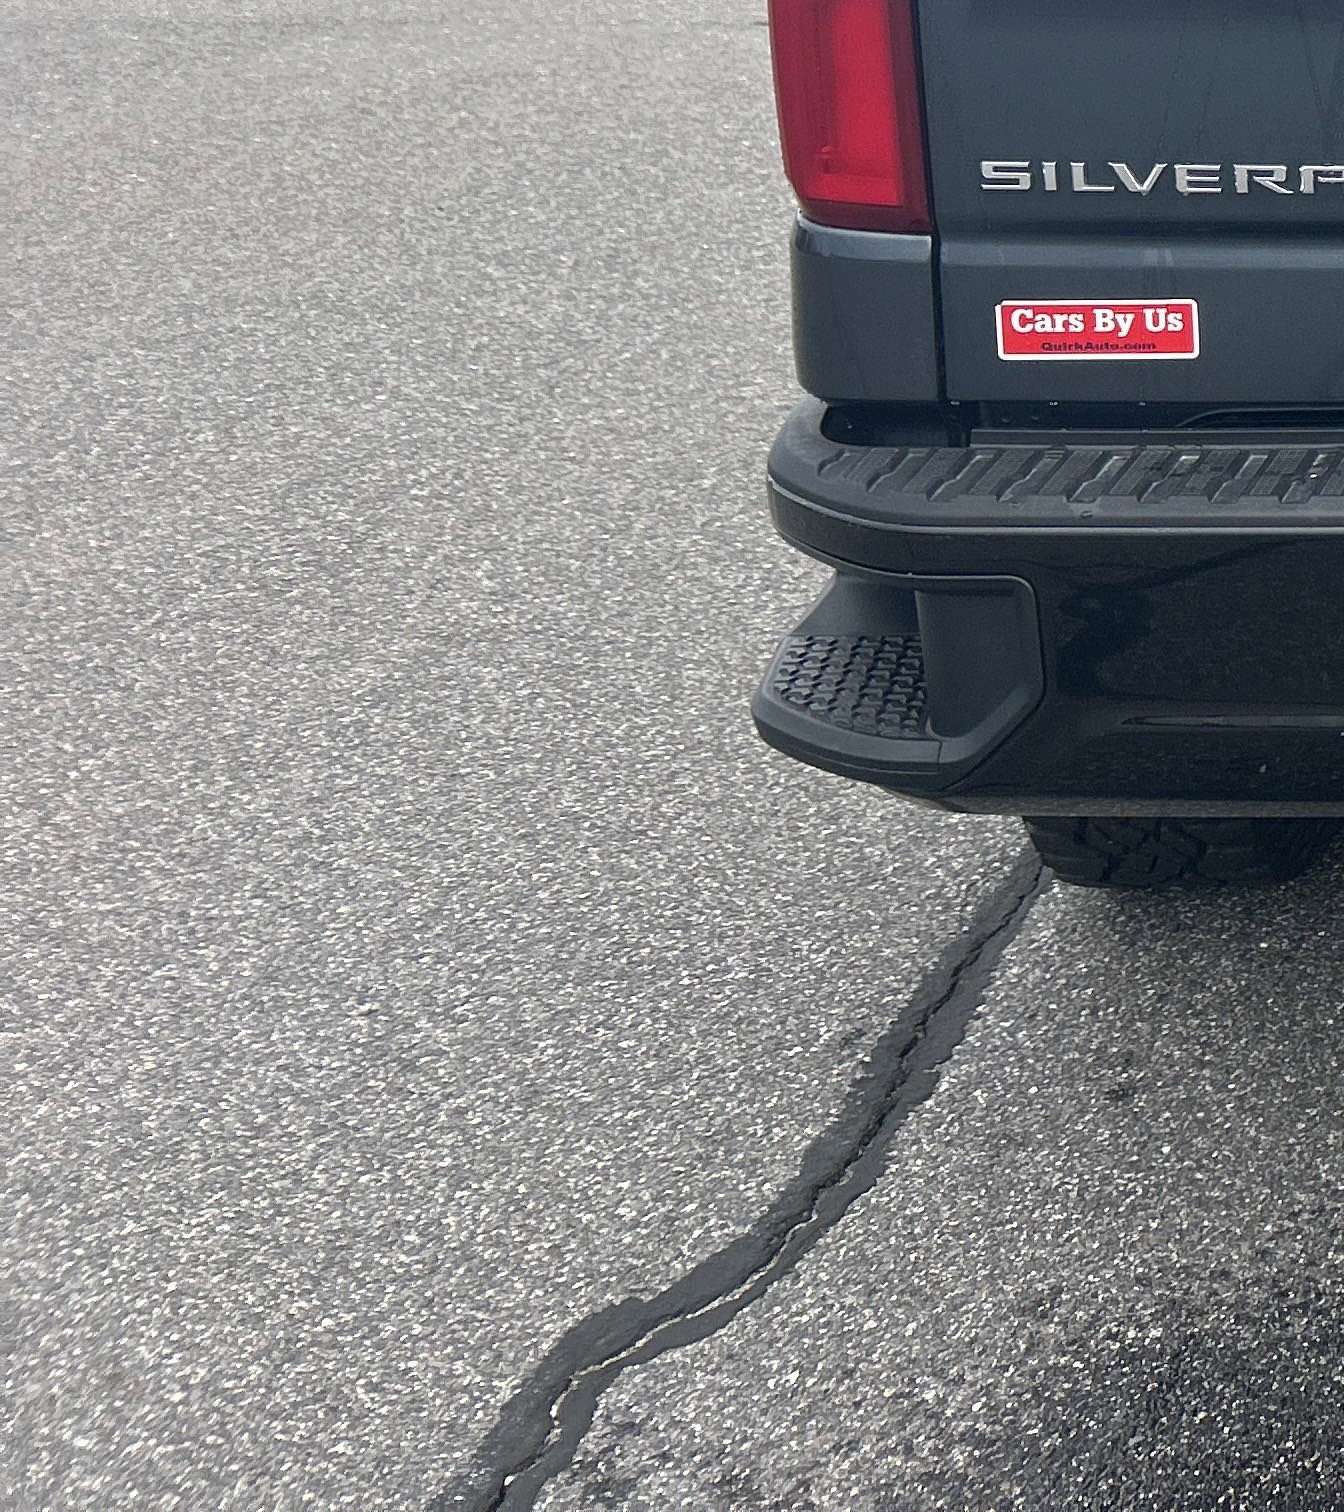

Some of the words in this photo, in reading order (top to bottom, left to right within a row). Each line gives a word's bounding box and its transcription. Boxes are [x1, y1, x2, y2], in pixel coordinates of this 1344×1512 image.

[1010, 308, 1085, 333] Cars
[1093, 308, 1136, 338] By
[1143, 307, 1185, 332] Us
[1041, 342, 1157, 352] QuirkAuto.com
